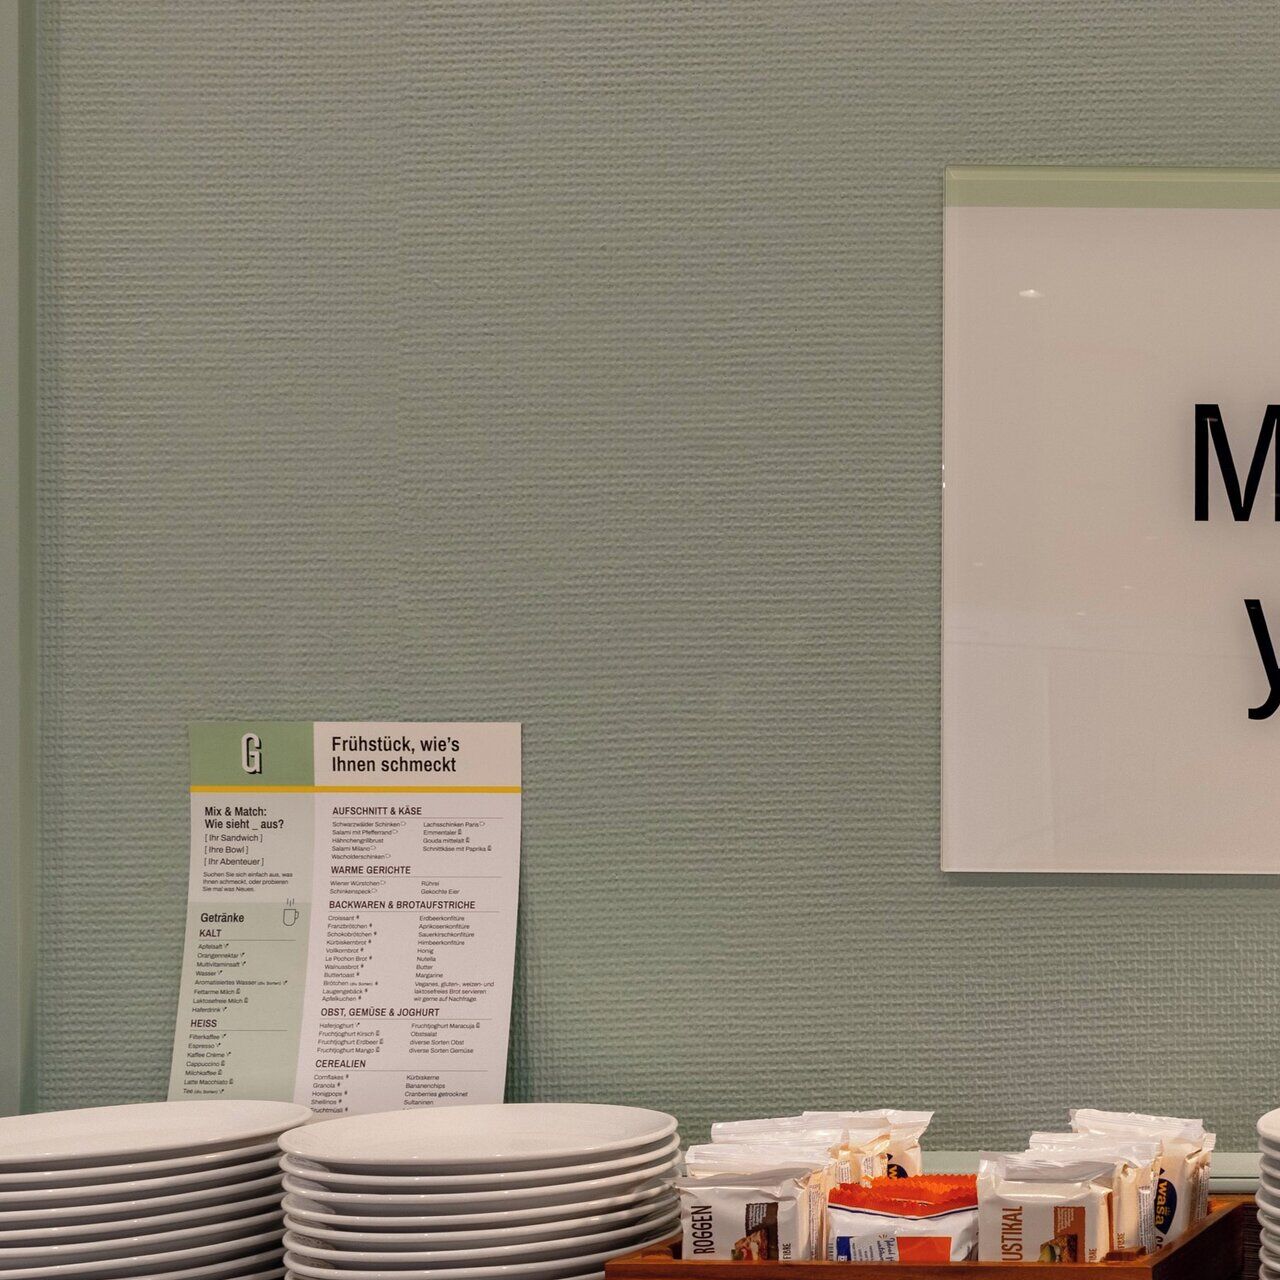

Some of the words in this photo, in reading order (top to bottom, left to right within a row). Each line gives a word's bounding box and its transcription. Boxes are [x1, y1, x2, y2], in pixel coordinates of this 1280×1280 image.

[331, 735, 414, 754] Frühstück,
[241, 732, 263, 774] G
[331, 756, 376, 773] Ihnen
[381, 756, 456, 773] schmeckt
[205, 807, 222, 816] Mix
[225, 807, 231, 816] &
[235, 807, 267, 816] Match:
[332, 807, 388, 815] AUFSCHNITT
[390, 807, 396, 815] &
[399, 805, 422, 815] KÄSE
[205, 819, 223, 828] Wie
[226, 819, 249, 829] sieht
[261, 819, 284, 828] aus?
[331, 866, 363, 874] WARME
[366, 866, 411, 874] GERICHTE
[329, 901, 385, 909] BACKWAREN
[388, 901, 394, 909] &
[396, 901, 475, 909] BROTAUFSTRICHE
[201, 913, 244, 923] Getränke
[199, 929, 222, 937] KALT
[321, 1008, 347, 1017] OBST,
[349, 1006, 386, 1017] GEMÜSE
[389, 1008, 395, 1017] &
[397, 1008, 440, 1017] JOGHURT
[1155, 1181, 1168, 1225] wasa
[691, 1205, 715, 1254] ROGGEN
[1002, 1206, 1023, 1262] USTIKAL
